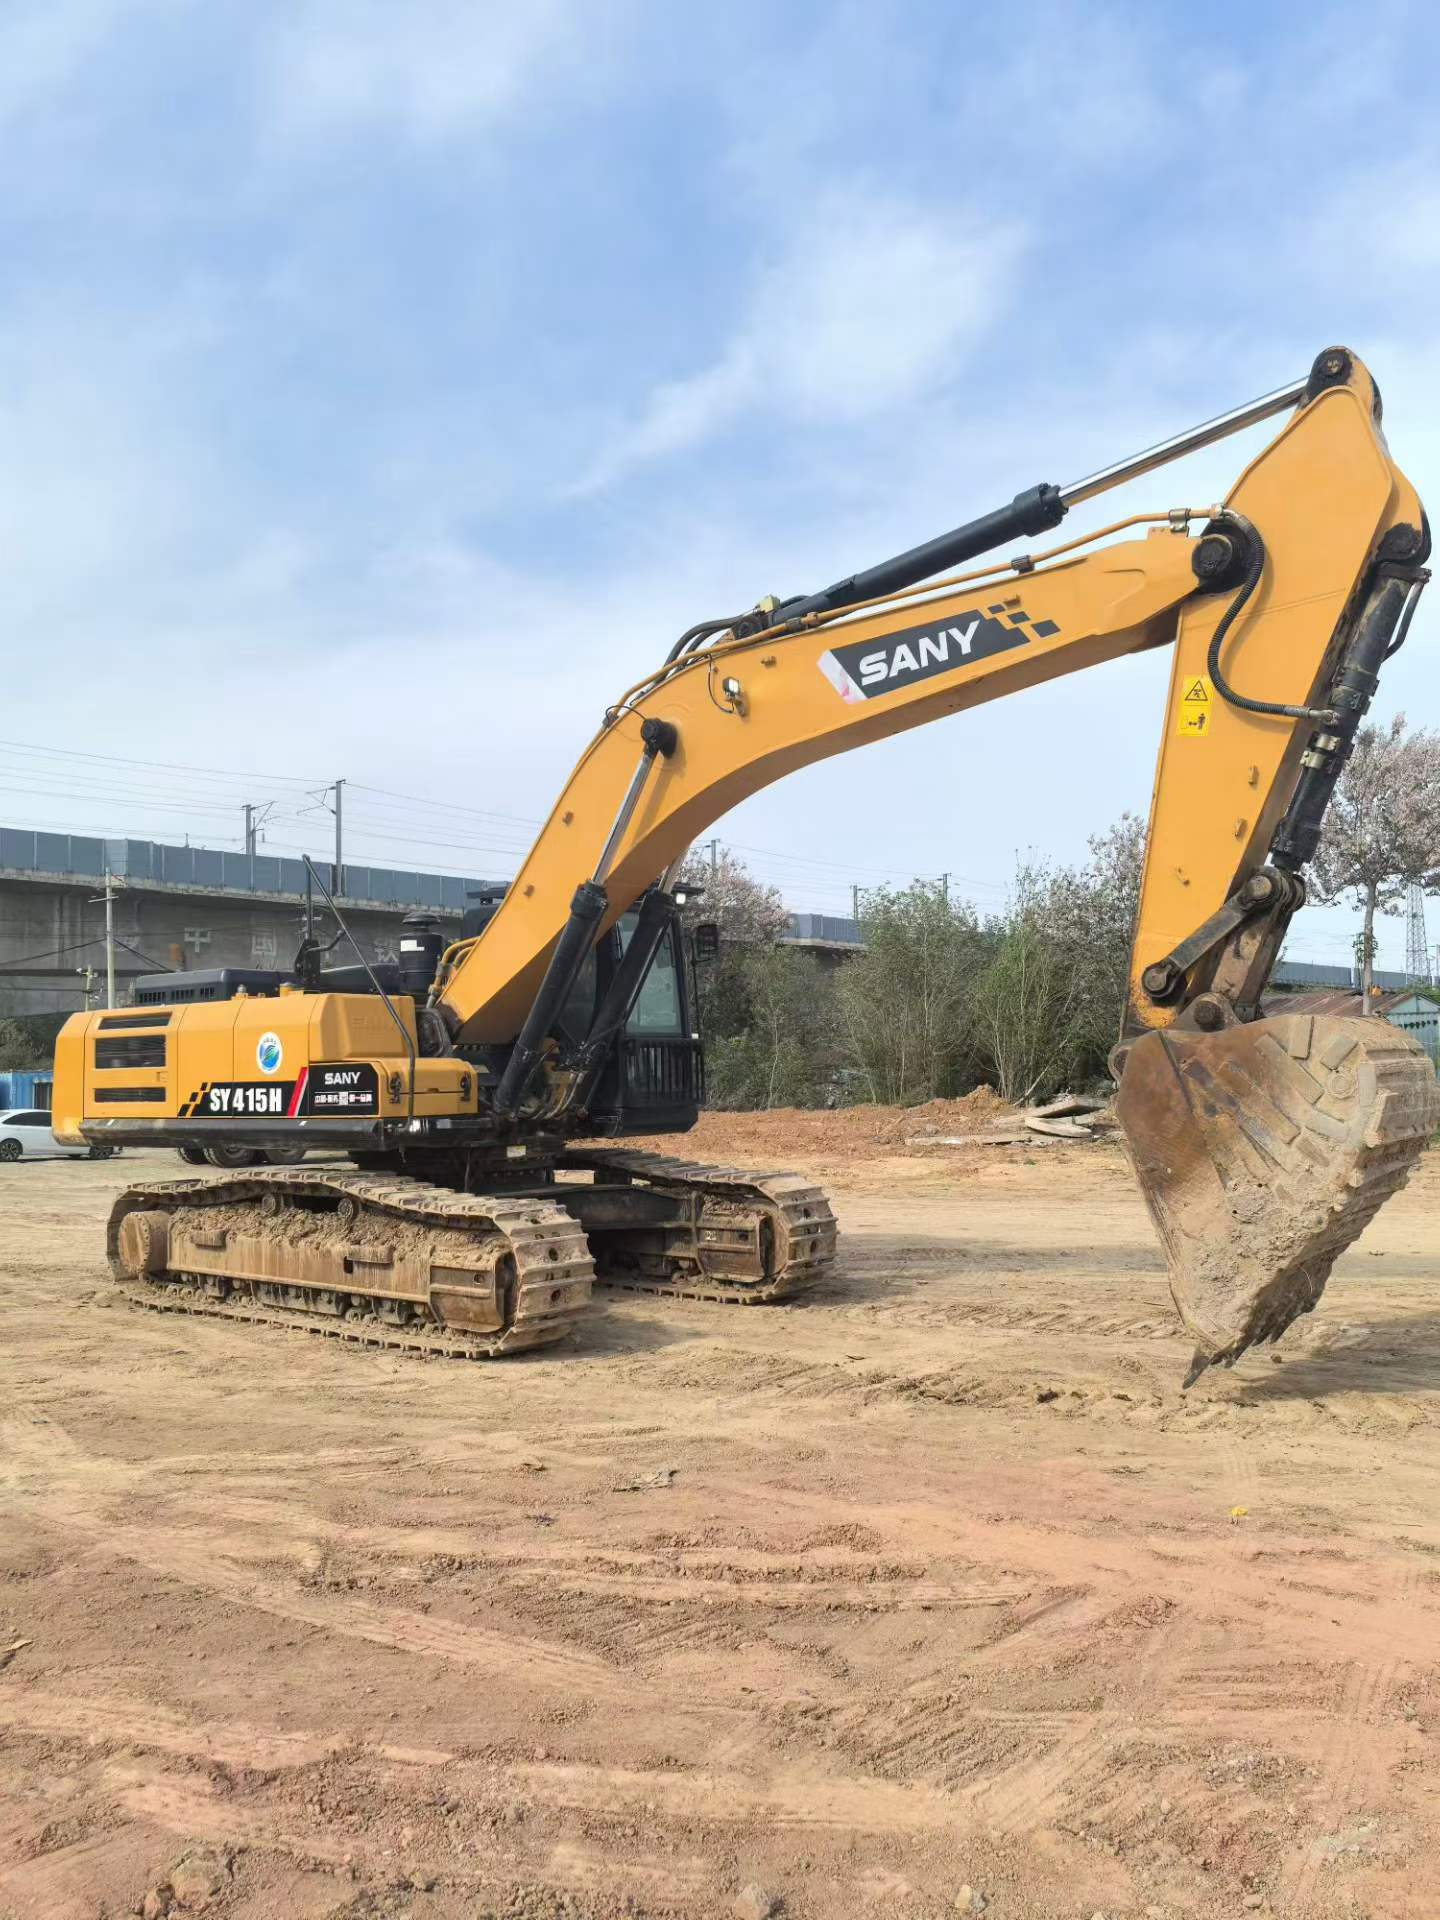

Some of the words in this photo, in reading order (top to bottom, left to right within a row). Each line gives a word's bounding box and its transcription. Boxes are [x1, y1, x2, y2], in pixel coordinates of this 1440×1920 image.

[858, 619, 981, 687] SANY
[324, 1071, 361, 1085] SANY
[209, 1087, 282, 1112] SY415H
